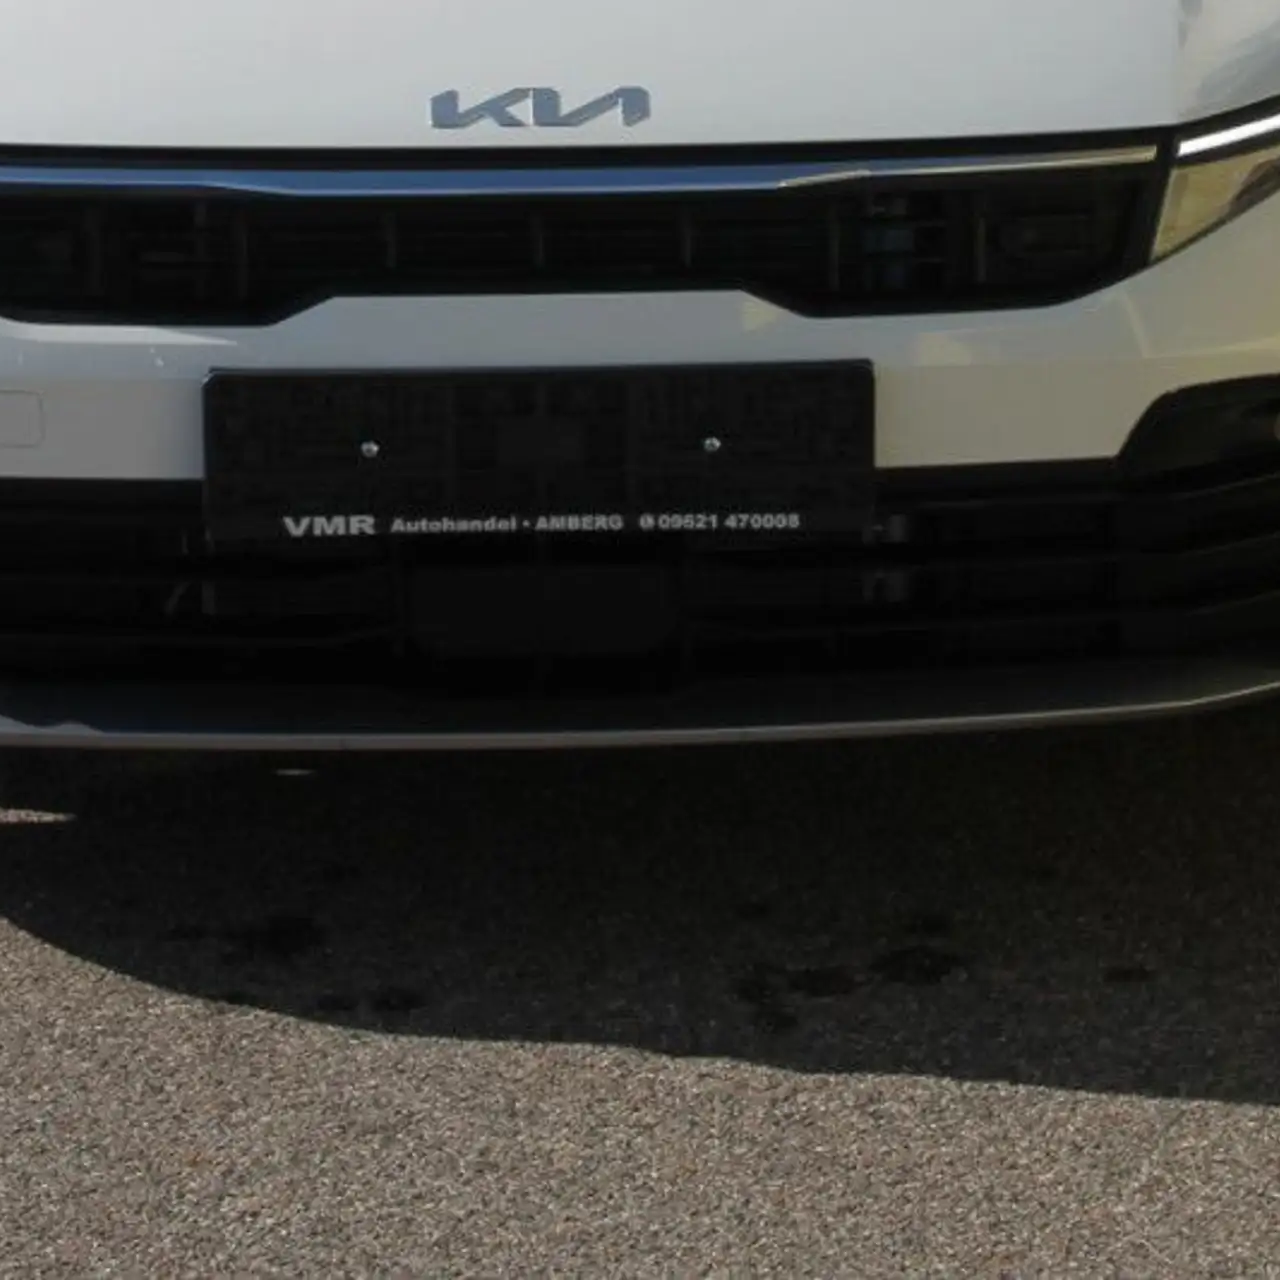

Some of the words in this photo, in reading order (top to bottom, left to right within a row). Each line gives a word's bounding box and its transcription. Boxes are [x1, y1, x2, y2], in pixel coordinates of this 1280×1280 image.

[282, 513, 376, 538] VMR
[389, 513, 518, 534] Autohandel
[534, 512, 624, 532] AMBERG
